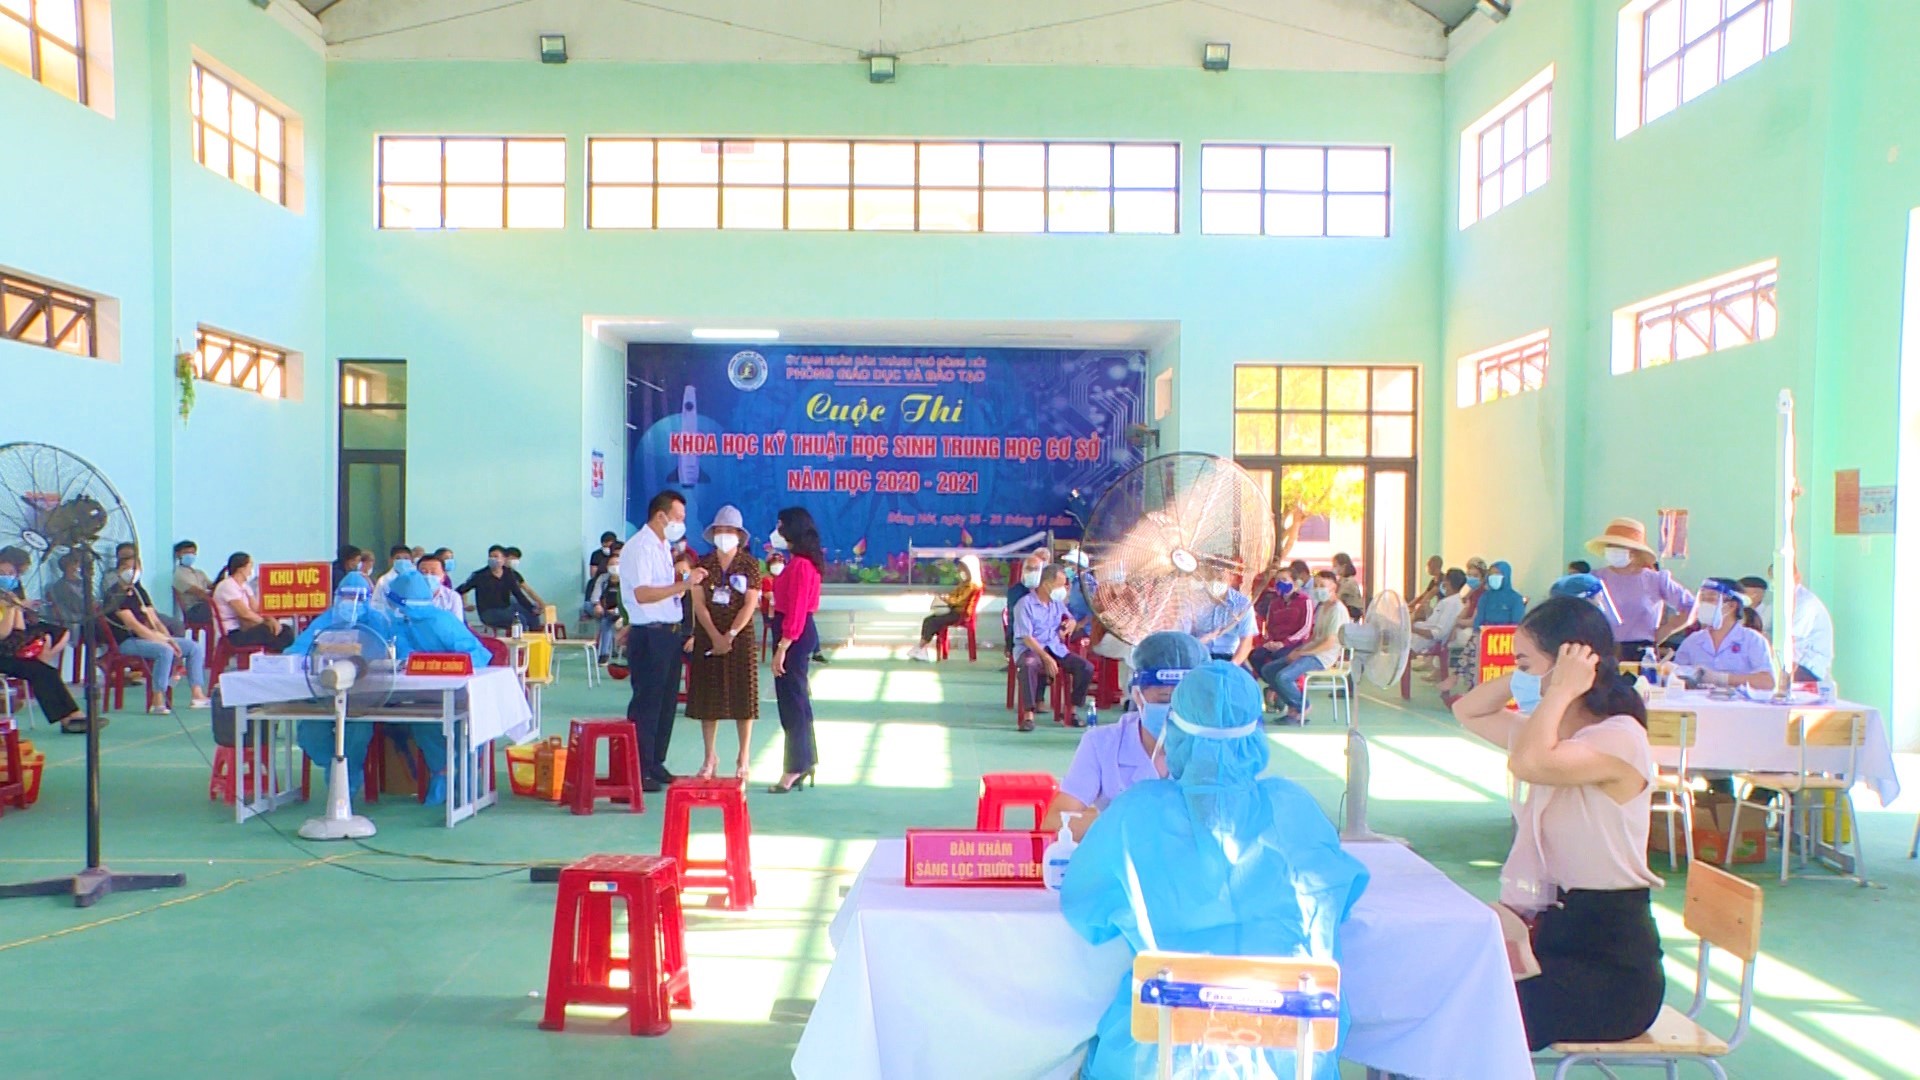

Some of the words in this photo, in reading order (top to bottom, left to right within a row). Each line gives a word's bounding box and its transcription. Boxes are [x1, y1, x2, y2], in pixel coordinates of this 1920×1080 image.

[806, 392, 886, 427] Cuộc
[900, 393, 964, 423] Thi
[669, 432, 718, 456] KHOA
[722, 433, 758, 459] HỌC
[763, 430, 788, 456] KỸ
[792, 432, 848, 461] THUẬT
[851, 435, 888, 461] HỌC
[893, 435, 937, 458] SINH
[941, 436, 1000, 459] TRUNG
[1004, 437, 1041, 463] HỌC
[1046, 436, 1072, 460] CƠ
[1074, 431, 1101, 461] SỞ
[787, 466, 830, 491] NĂM
[834, 470, 871, 495] HỌC
[875, 471, 920, 493] 2020
[936, 472, 979, 494] 2021
[270, 569, 294, 586] KHU
[296, 567, 320, 588] VỰC
[263, 593, 281, 609] THEO
[950, 839, 975, 856] BÀN
[978, 840, 1013, 856] KHÁM
[951, 863, 974, 881] LỌC
[978, 860, 1015, 877] TRƯỚC
